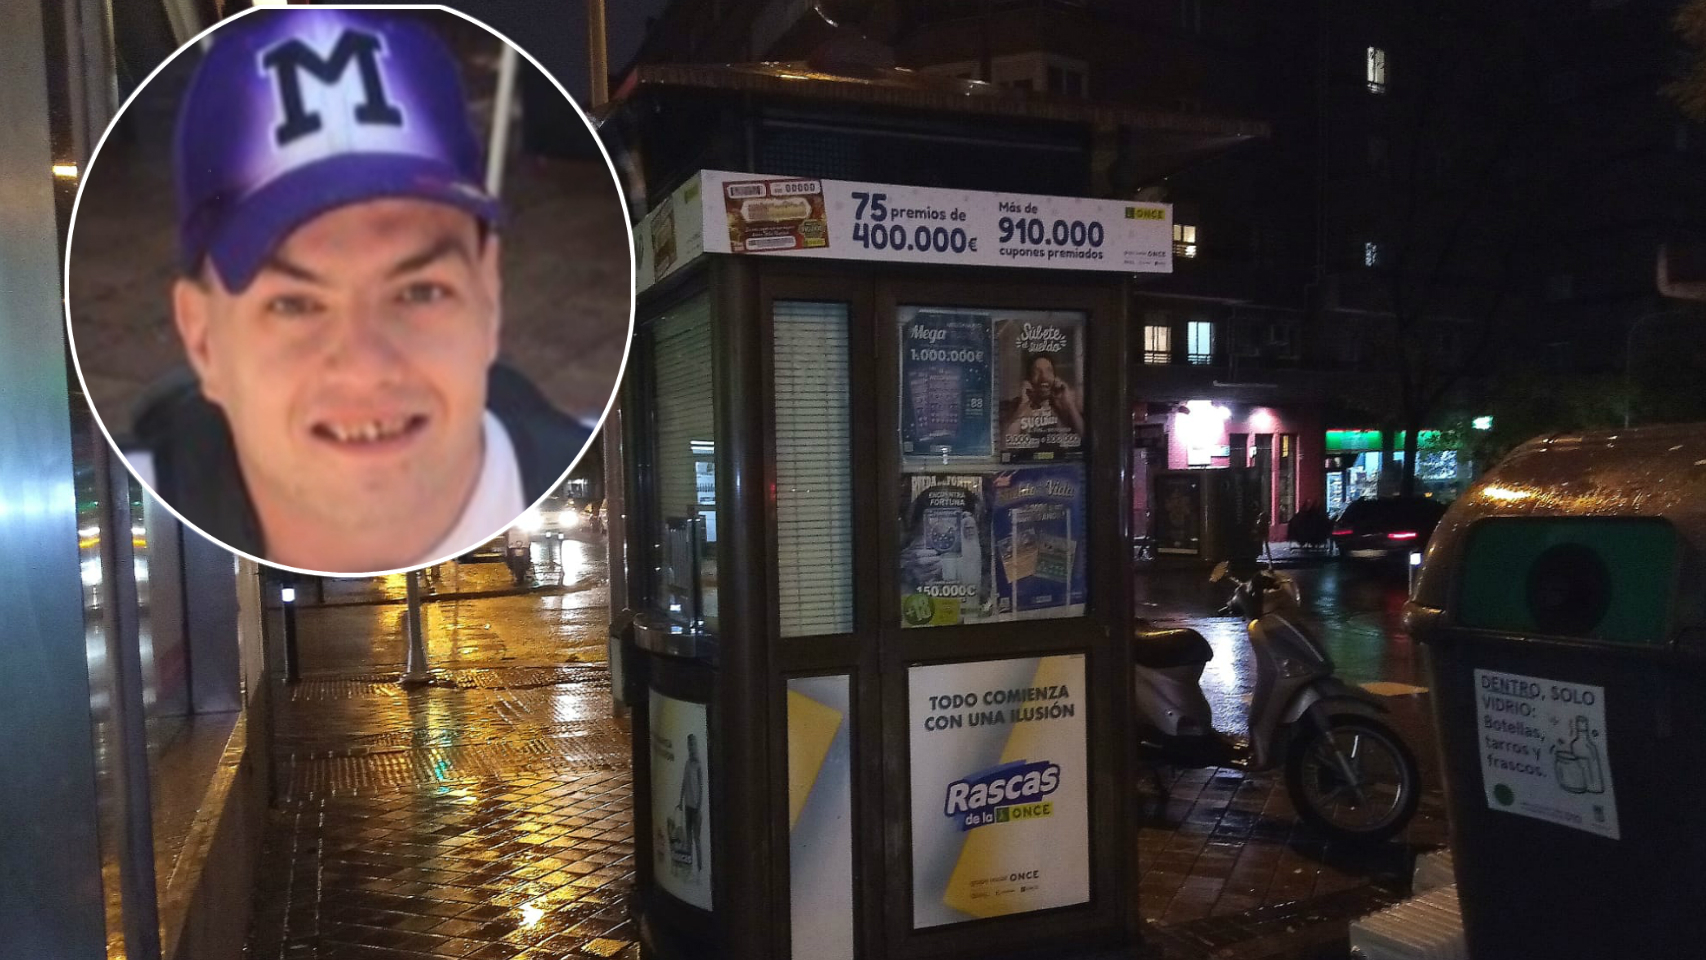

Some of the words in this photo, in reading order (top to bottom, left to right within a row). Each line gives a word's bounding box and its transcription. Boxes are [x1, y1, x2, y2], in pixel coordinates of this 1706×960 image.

[261, 26, 404, 149] M
[851, 191, 888, 222] 75
[890, 206, 947, 222] premios
[949, 207, 967, 222] de
[998, 201, 1022, 214] Más
[1024, 203, 1039, 215] de
[1136, 208, 1165, 220] ONCE
[852, 222, 978, 254] 400.000€
[998, 216, 1105, 248] 910.000
[999, 247, 1046, 260] cupones
[1047, 248, 1104, 261] premiados
[910, 324, 948, 344] Mega
[910, 348, 985, 363] 1.000.000€
[930, 498, 966, 506] FORTUNA
[928, 693, 978, 711] TODO
[982, 685, 1070, 706] COMIENZA
[1481, 675, 1546, 701] DENTRO,
[1550, 686, 1596, 706] SOLO
[924, 715, 963, 732] CON
[968, 710, 1005, 728] UNA
[1010, 701, 1075, 723] ILUSIÓN
[1482, 695, 1537, 718] VIDRIO:
[1483, 714, 1547, 742] Botellas,
[1485, 735, 1530, 756] tarros
[1532, 746, 1542, 762] y
[1486, 755, 1548, 778] frascos.
[946, 764, 1060, 816] Rascas
[965, 811, 981, 826] de
[982, 810, 994, 824] la
[1012, 804, 1052, 820] ONCE
[1009, 870, 1040, 883] ONCE
